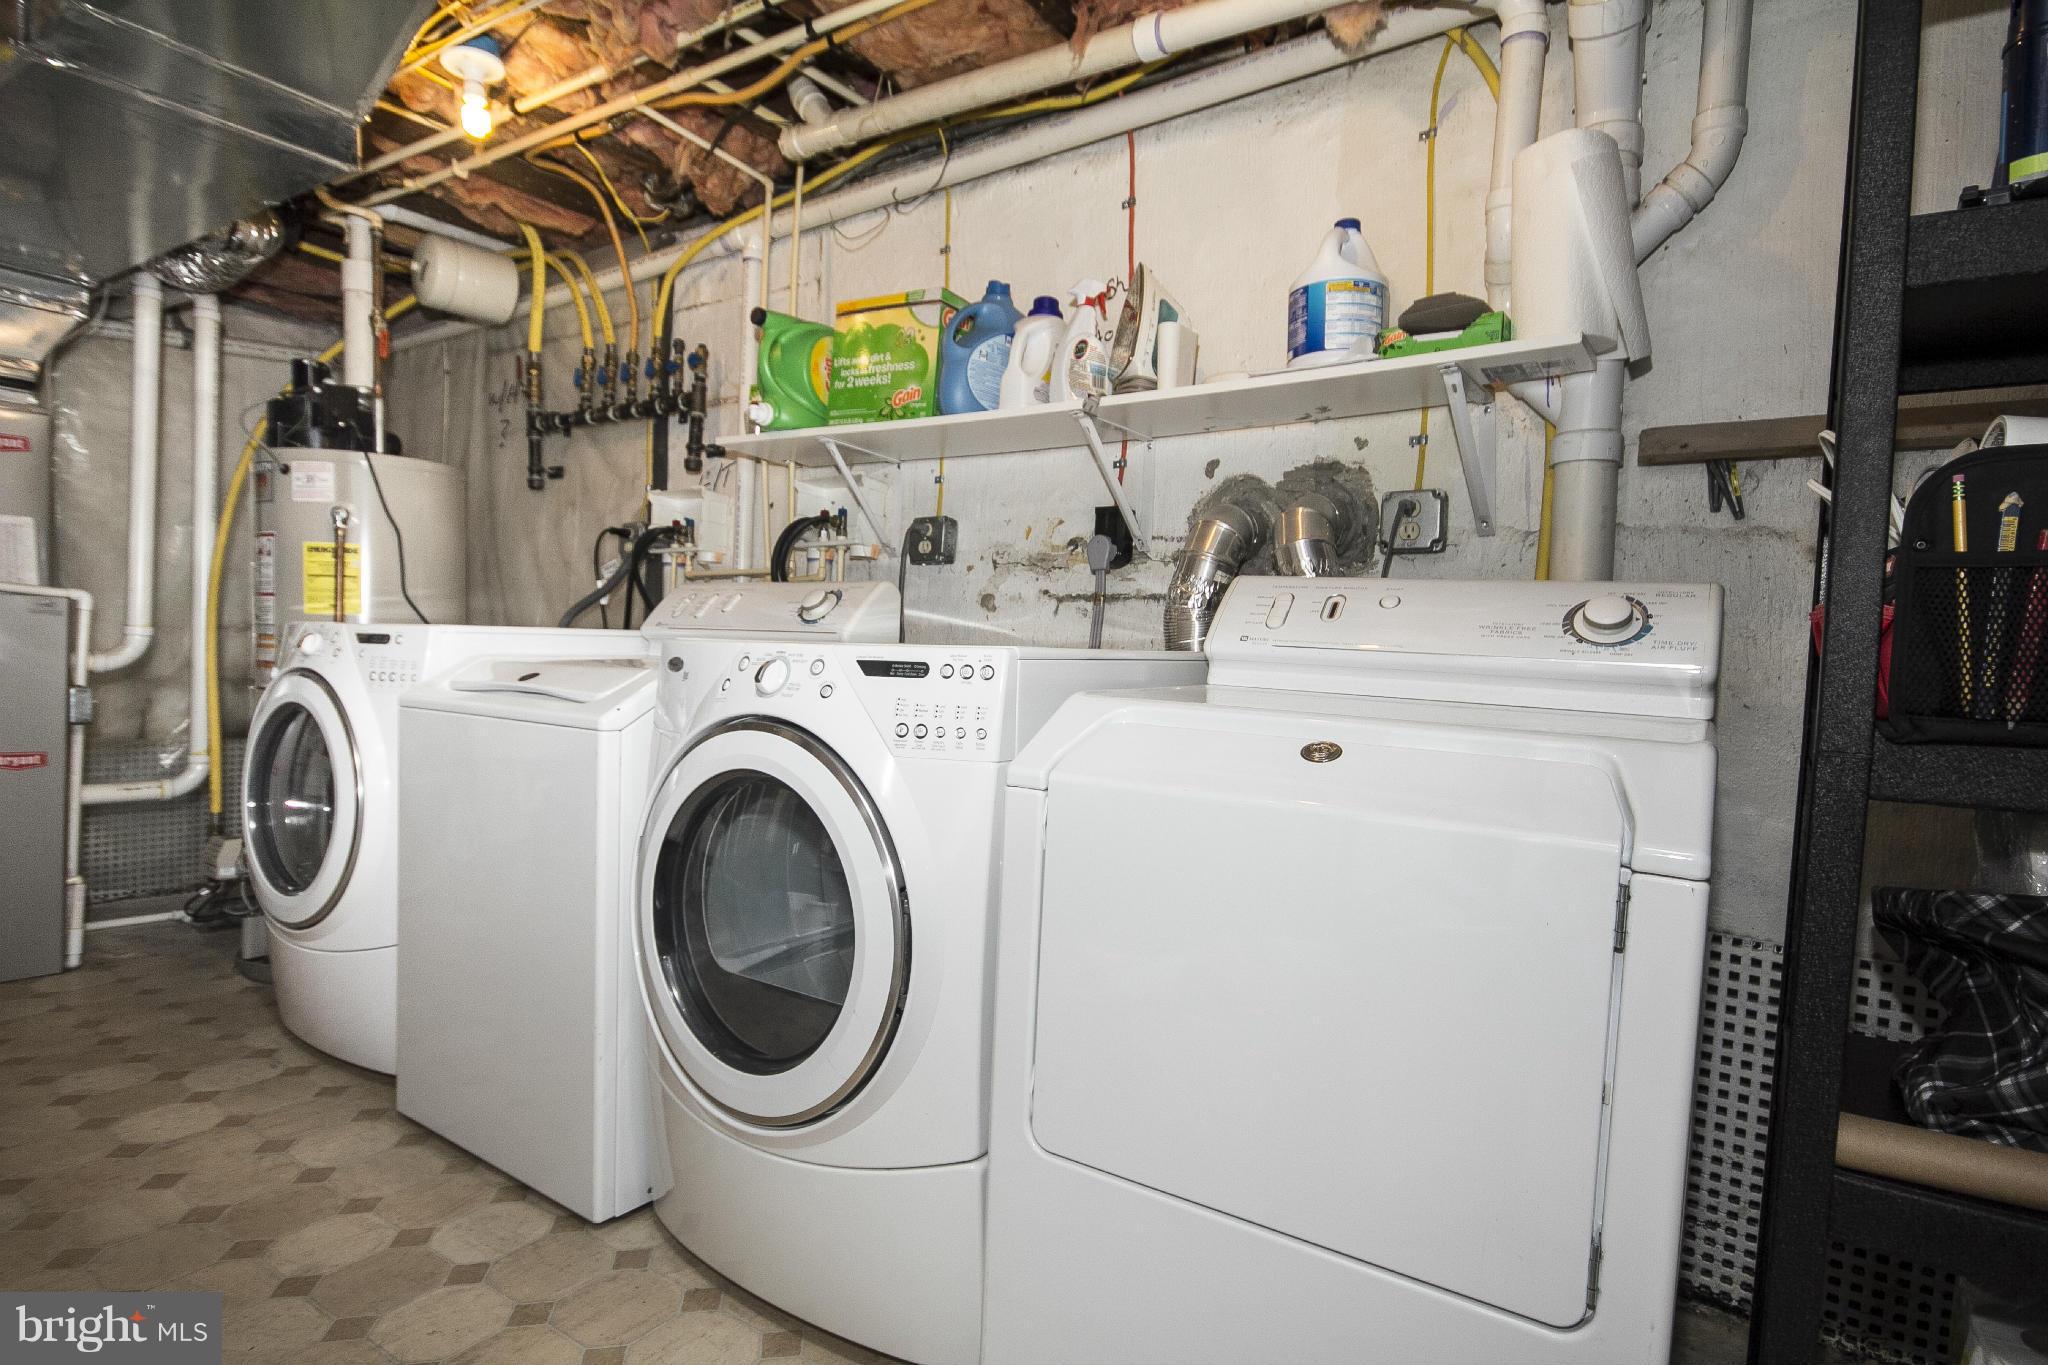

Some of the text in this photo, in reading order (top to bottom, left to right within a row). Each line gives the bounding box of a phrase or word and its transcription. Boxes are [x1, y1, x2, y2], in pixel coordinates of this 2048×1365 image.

[868, 360, 916, 373] freshness
[846, 376, 854, 388] 2
[855, 373, 891, 387] weeks!
[892, 386, 922, 408] Gain
